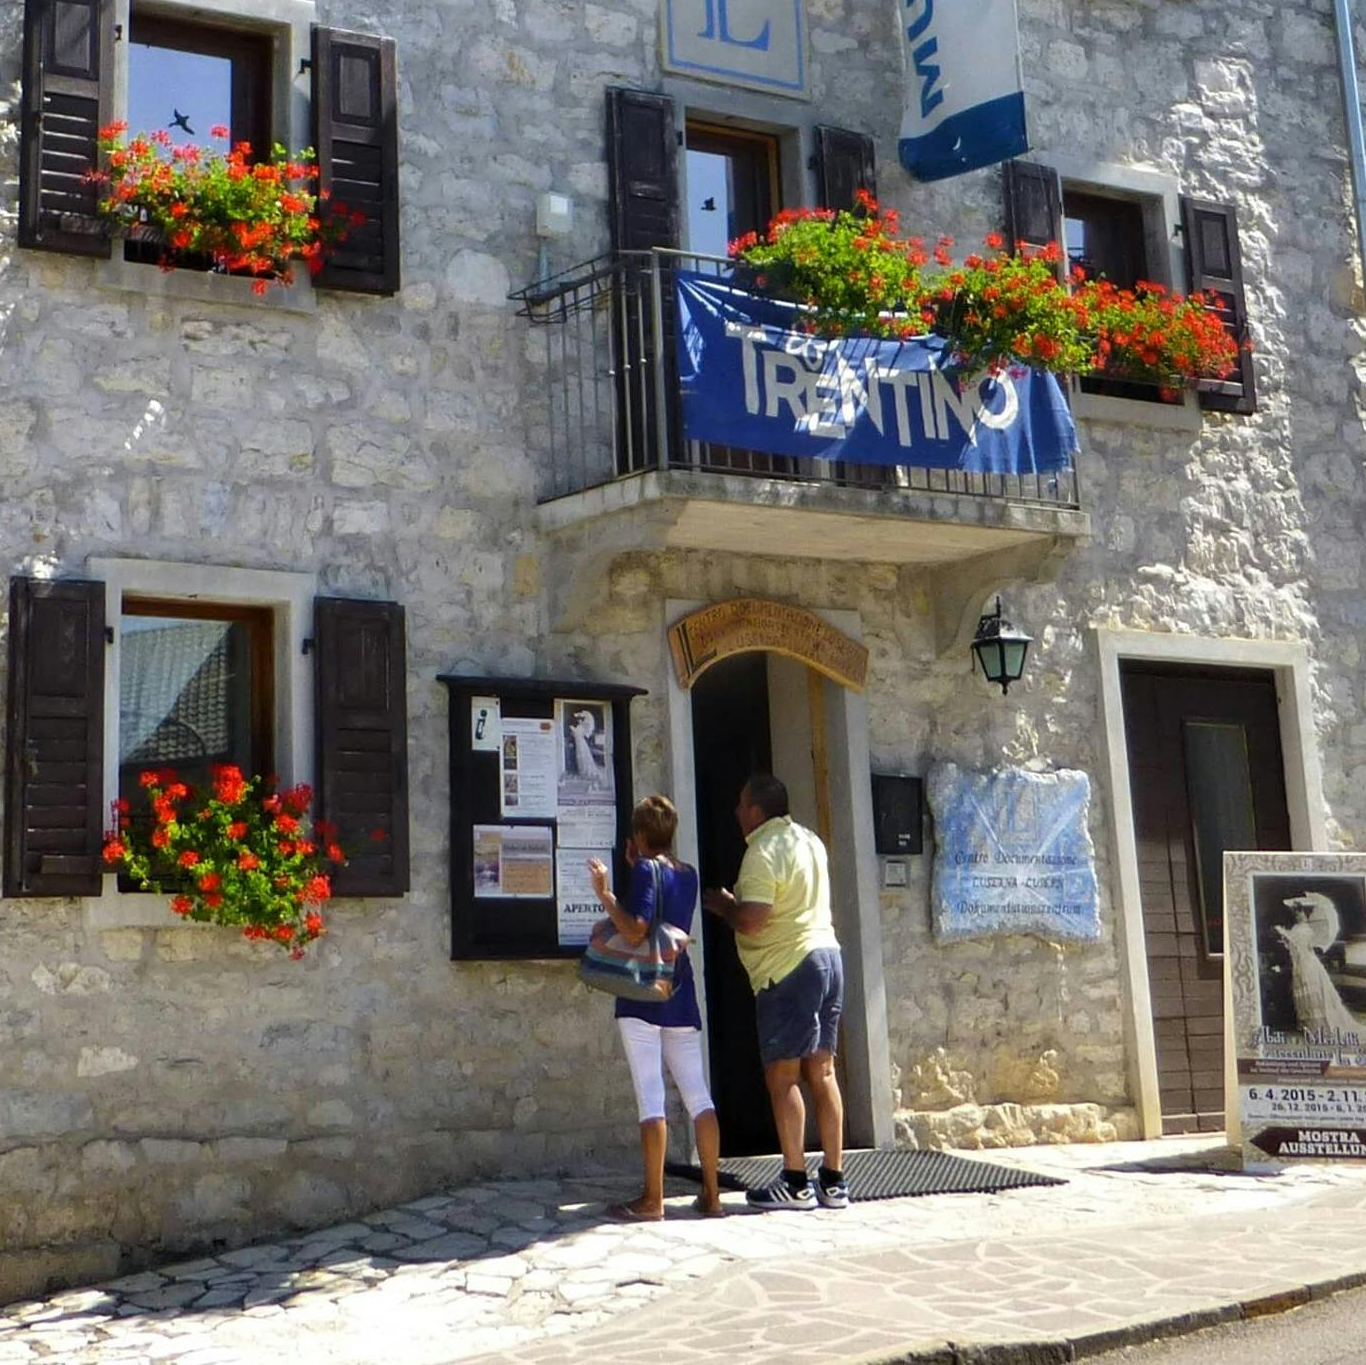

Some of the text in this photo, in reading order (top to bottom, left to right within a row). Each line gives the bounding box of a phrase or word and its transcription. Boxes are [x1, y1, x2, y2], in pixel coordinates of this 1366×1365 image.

[724, 320, 1020, 448] TRENTINO
[564, 903, 605, 913] APERTO
[1298, 1130, 1360, 1143] MOSTRA
